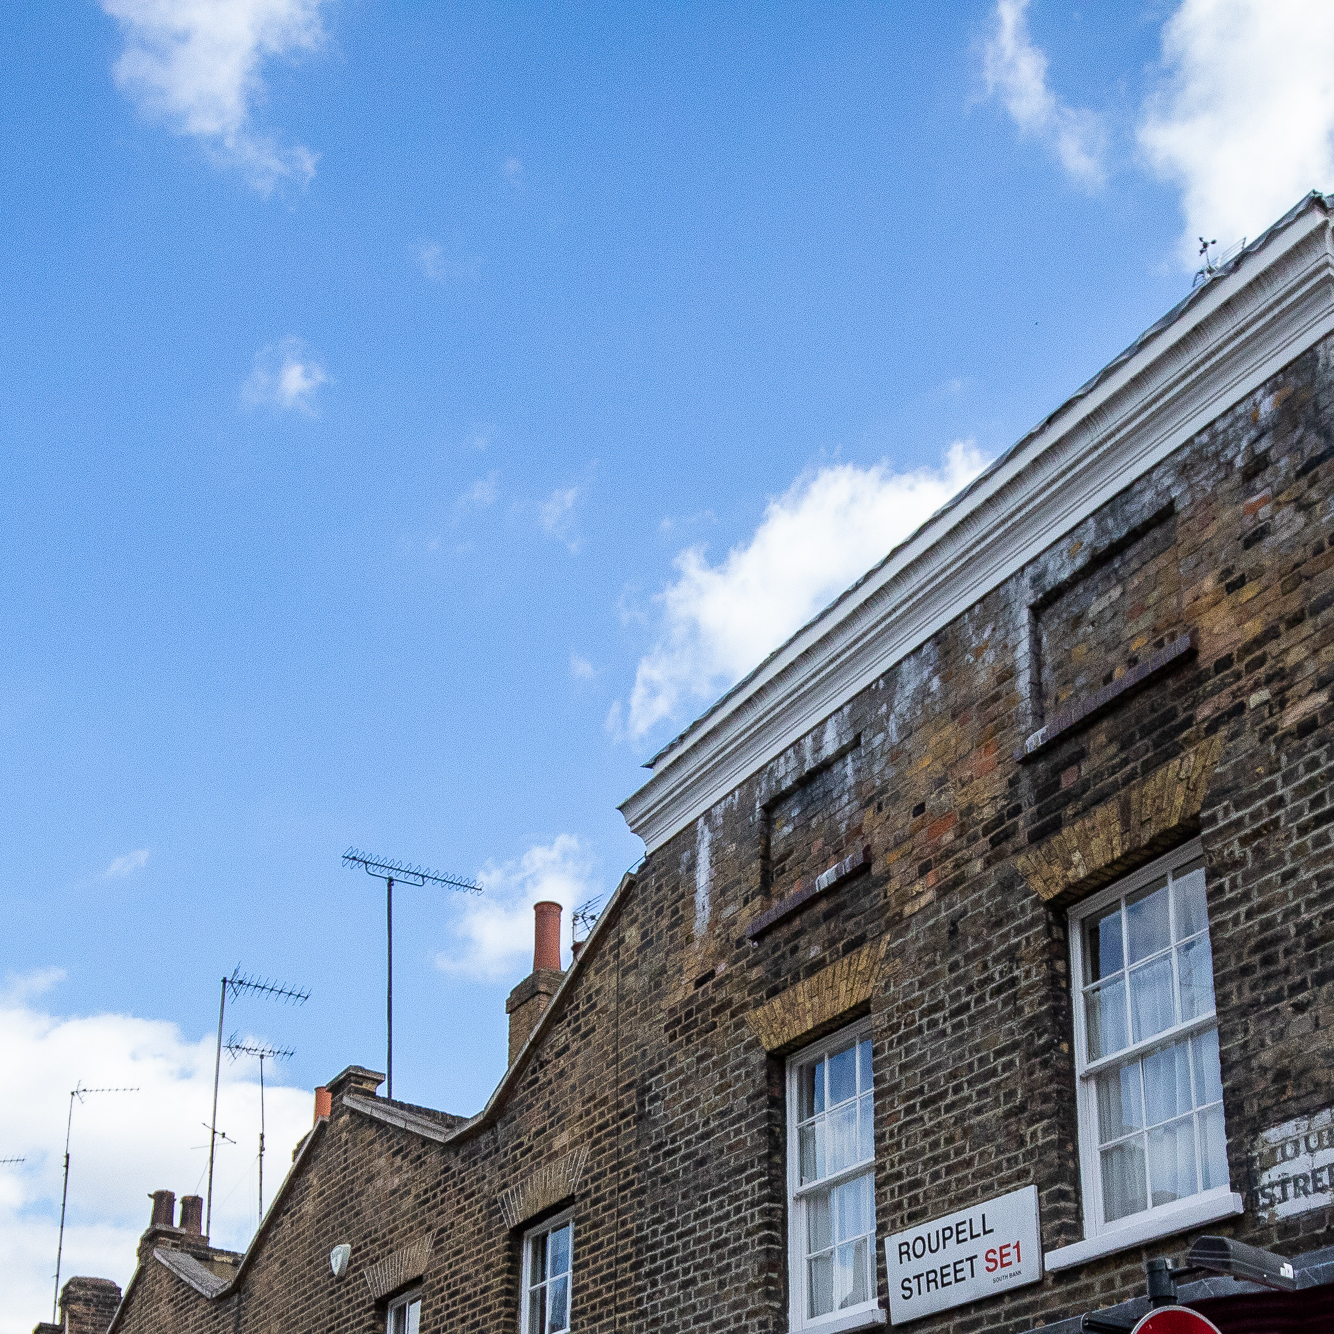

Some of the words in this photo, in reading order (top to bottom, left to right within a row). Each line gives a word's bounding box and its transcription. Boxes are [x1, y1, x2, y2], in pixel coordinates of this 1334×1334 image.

[897, 1213, 995, 1265] ROUPELL
[900, 1254, 978, 1301] STREET
[984, 1240, 1022, 1273] SE1
[992, 1273, 1008, 1284] SOUTH
[1009, 1270, 1022, 1279] BANK
